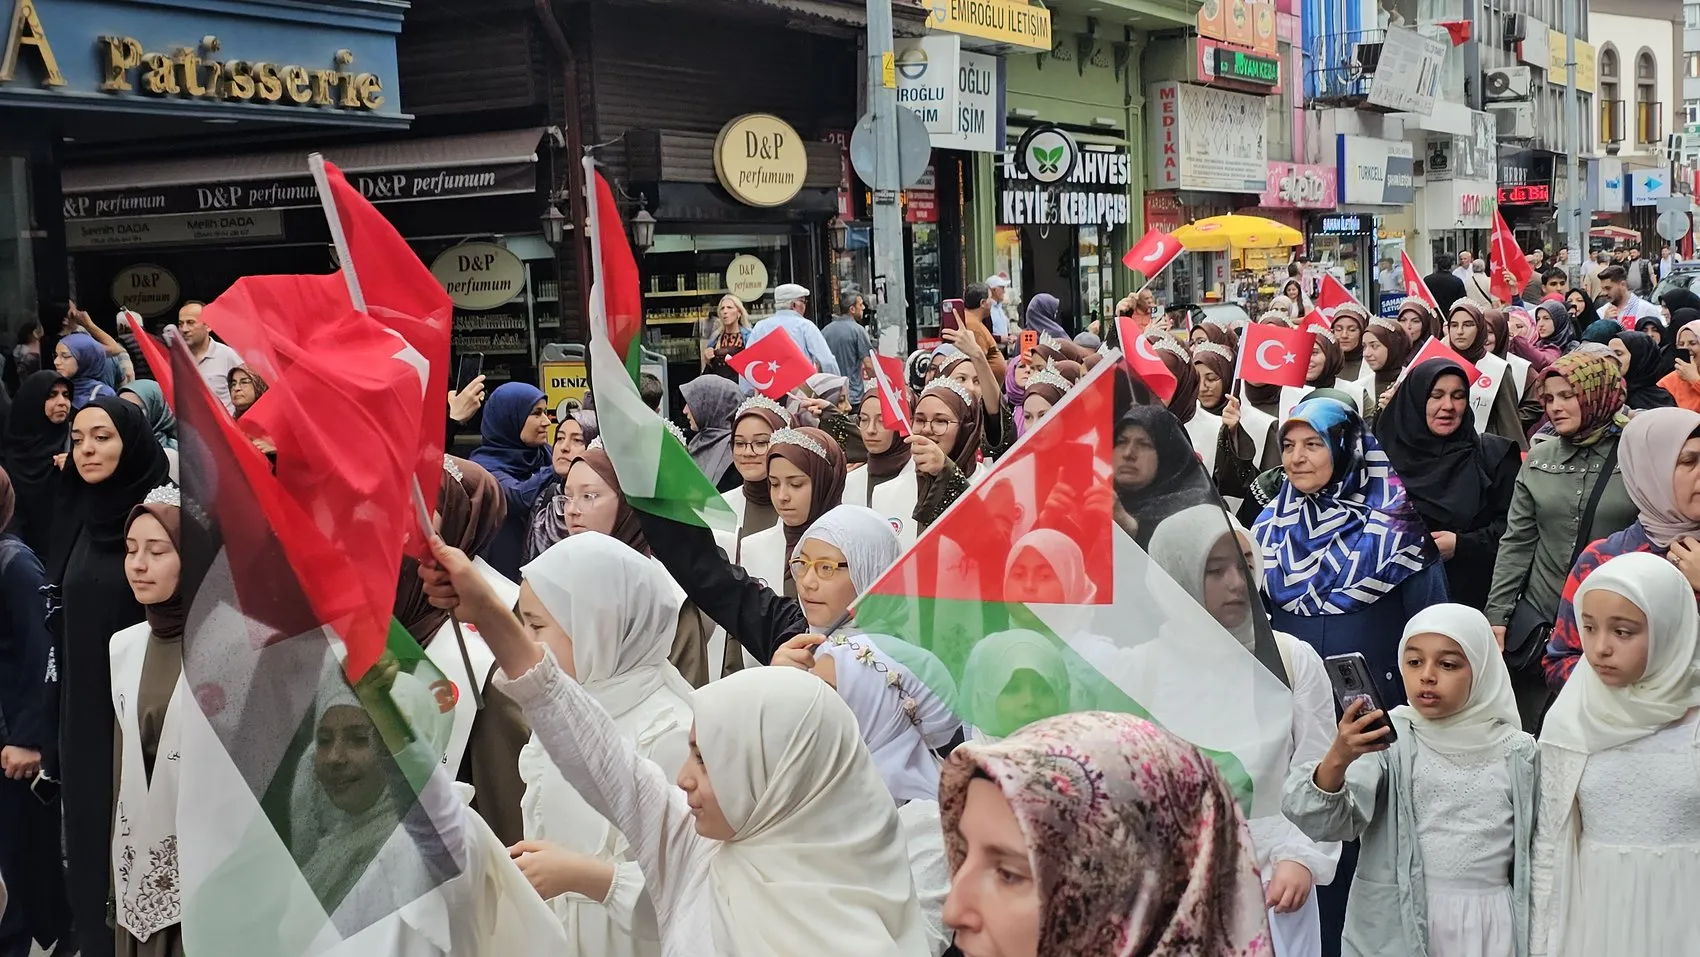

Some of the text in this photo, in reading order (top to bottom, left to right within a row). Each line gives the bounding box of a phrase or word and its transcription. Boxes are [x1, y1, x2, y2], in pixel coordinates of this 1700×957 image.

[1008, 5, 1048, 43] İLETİŞİM
[0, 0, 385, 110] A Patisserie
[745, 130, 784, 160] D&P
[1160, 87, 1176, 182] MEDİKAL
[738, 166, 794, 188] perfumum
[1067, 152, 1132, 184] AHVESİ
[95, 193, 166, 214] perfumum
[198, 186, 242, 210] D&P
[358, 173, 406, 198] D&P
[412, 170, 496, 195] perfumum
[457, 254, 495, 272] D&P
[739, 264, 755, 276] D&P
[130, 271, 160, 288] D&P
[447, 278, 511, 296] perfumum
[734, 278, 762, 292] perfumum
[551, 374, 587, 388] DENİZ
